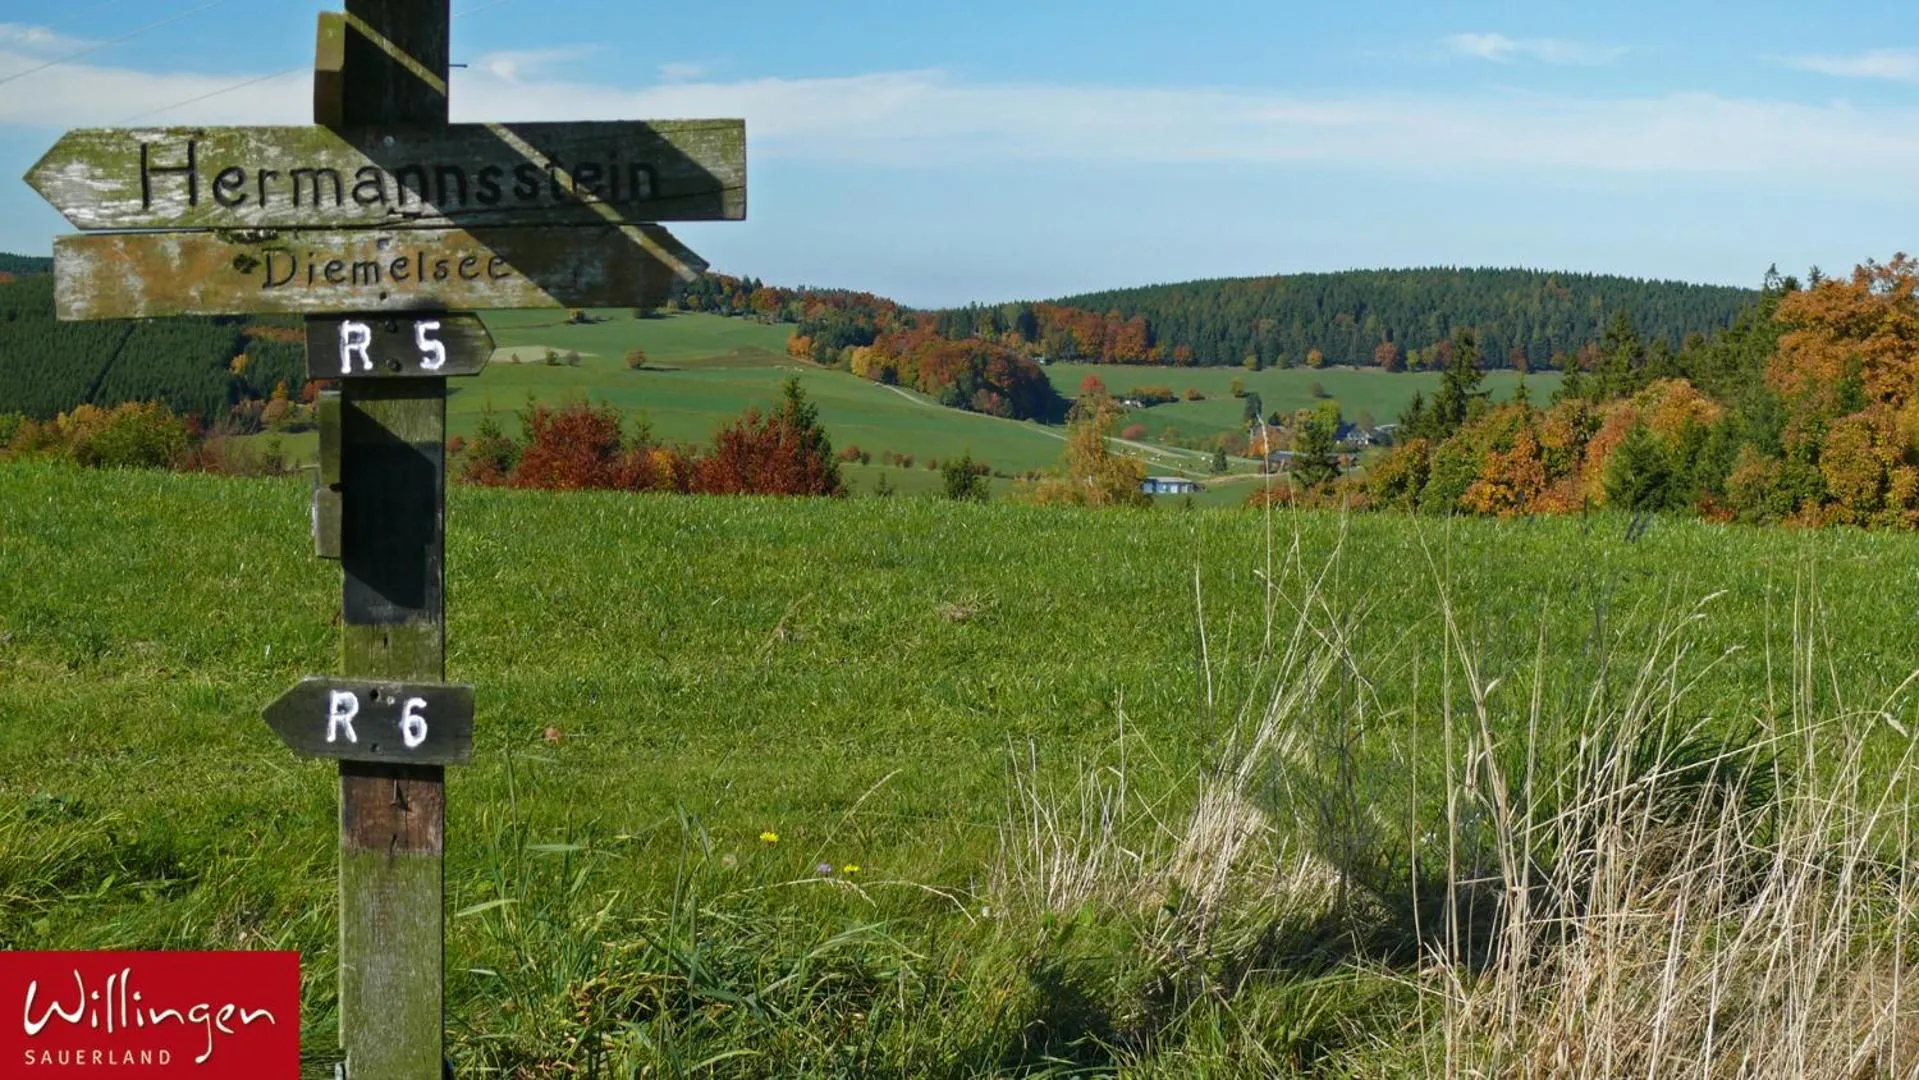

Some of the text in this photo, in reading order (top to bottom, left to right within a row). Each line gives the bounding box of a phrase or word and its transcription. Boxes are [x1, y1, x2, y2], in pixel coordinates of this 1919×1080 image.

[139, 141, 661, 211] Hermannsstein
[261, 247, 512, 289] Diemelsee
[339, 319, 447, 375] R 5
[325, 690, 429, 749] R 6
